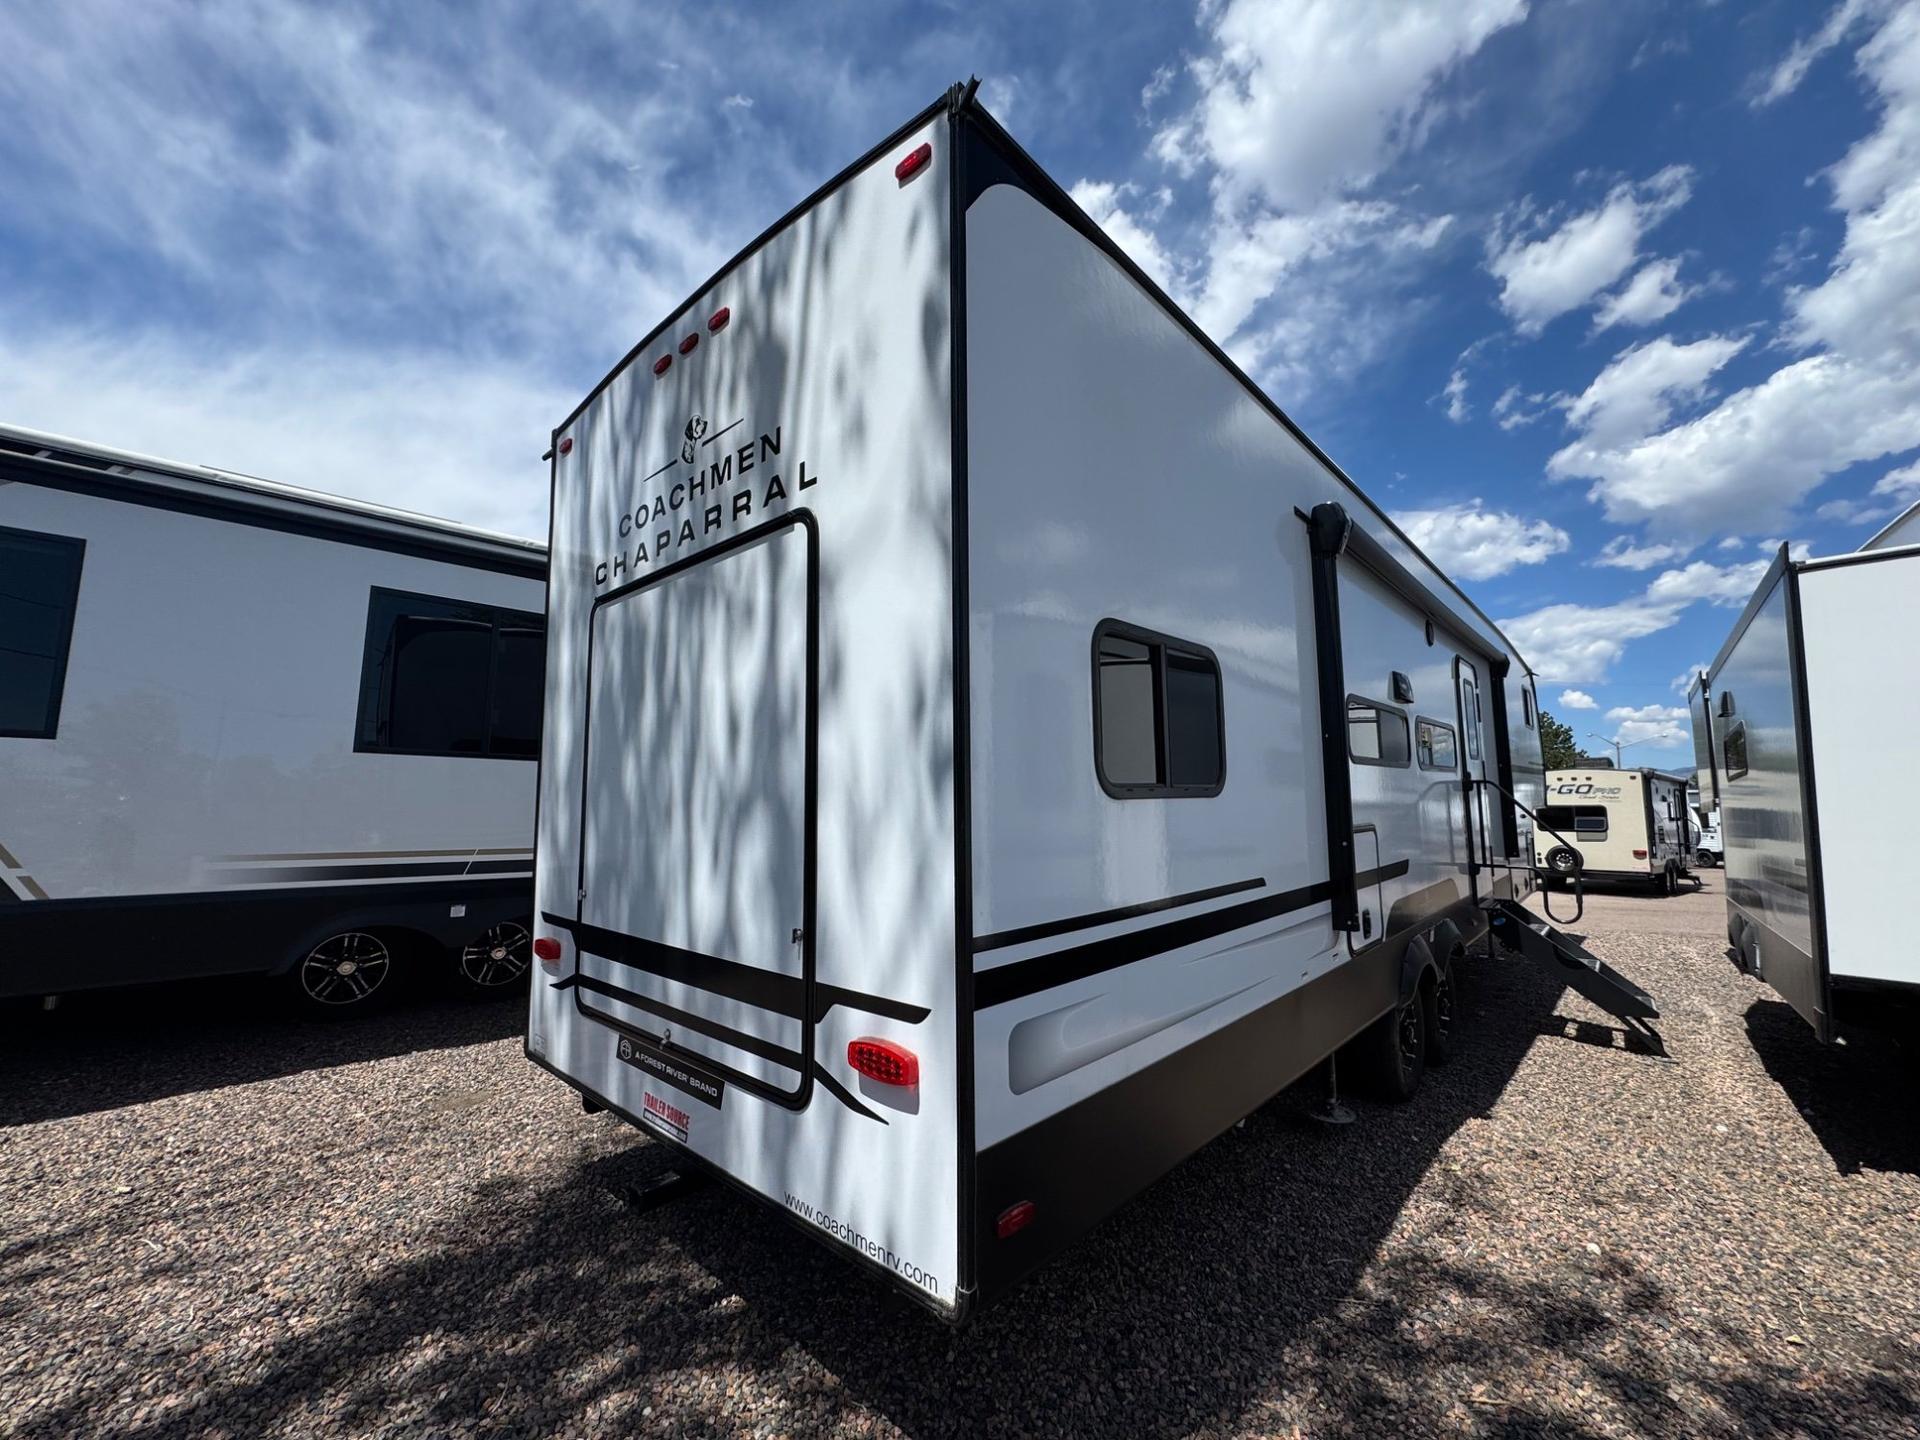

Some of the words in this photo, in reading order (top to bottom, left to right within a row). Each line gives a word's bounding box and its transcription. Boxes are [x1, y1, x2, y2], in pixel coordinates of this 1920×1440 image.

[595, 461, 818, 586] CHAPARRAL
[618, 426, 781, 538] COACHMEN
[634, 1051, 640, 1059] A
[640, 1054, 666, 1074] FOREST
[689, 1078, 718, 1097] BRAND
[644, 1091, 667, 1118] TRAILER
[666, 1103, 690, 1131] SOURCE
[784, 1191, 938, 1294] www.coachmenrv.com
